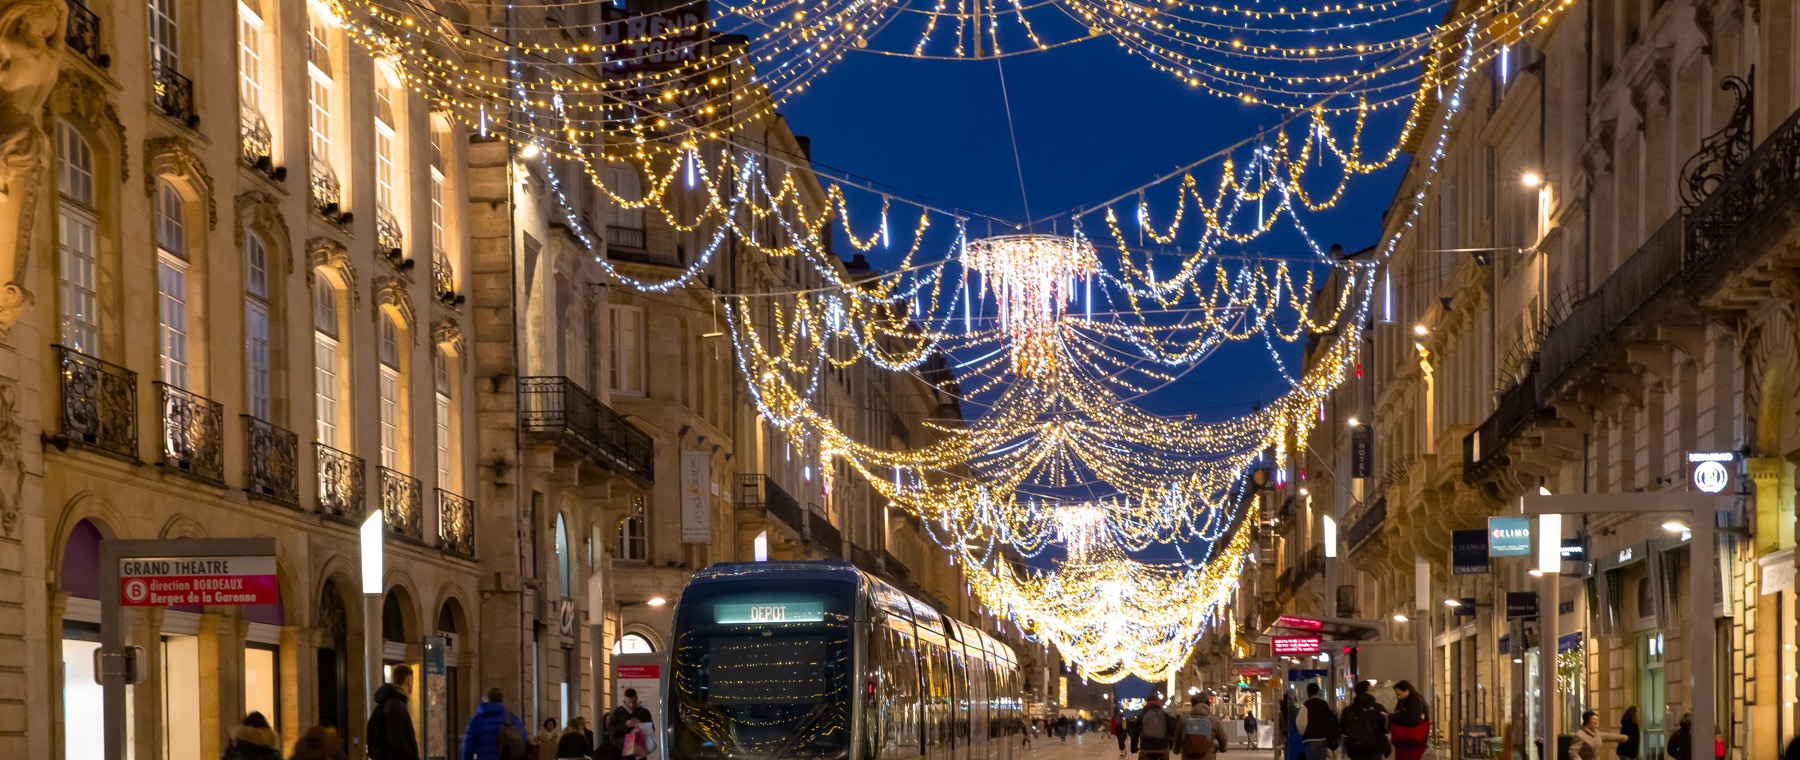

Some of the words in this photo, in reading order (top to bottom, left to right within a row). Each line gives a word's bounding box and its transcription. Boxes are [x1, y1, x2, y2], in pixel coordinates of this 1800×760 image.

[1492, 528, 1530, 539] CELIMO
[124, 562, 170, 575] GRAND
[175, 561, 228, 575] THEATRE
[150, 579, 190, 591] direction
[193, 578, 243, 590] BORDEAUX
[150, 592, 184, 606] Berges
[187, 591, 199, 603] de
[202, 591, 212, 603] la
[215, 591, 257, 603] Garonne
[751, 605, 786, 620] DEPOT
